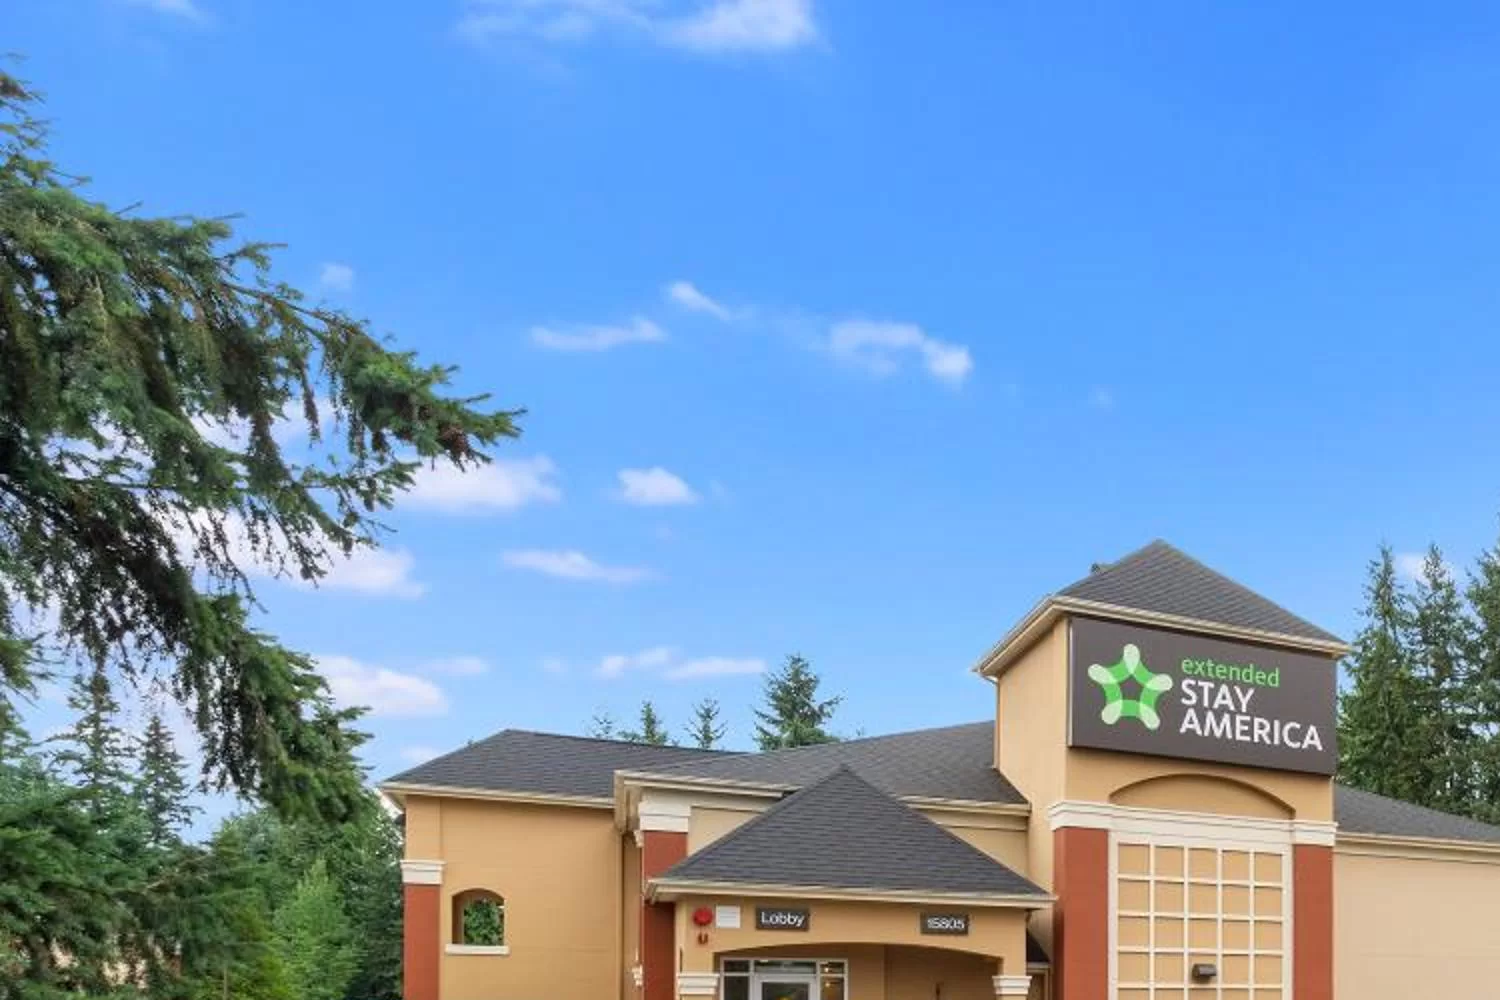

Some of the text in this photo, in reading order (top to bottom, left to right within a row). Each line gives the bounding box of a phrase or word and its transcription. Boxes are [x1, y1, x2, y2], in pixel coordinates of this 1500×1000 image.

[1181, 657, 1280, 687] extended
[1180, 679, 1255, 713] STAY
[1179, 708, 1323, 751] AMERICA
[761, 912, 805, 927] Lobby
[927, 917, 965, 930] 15805
